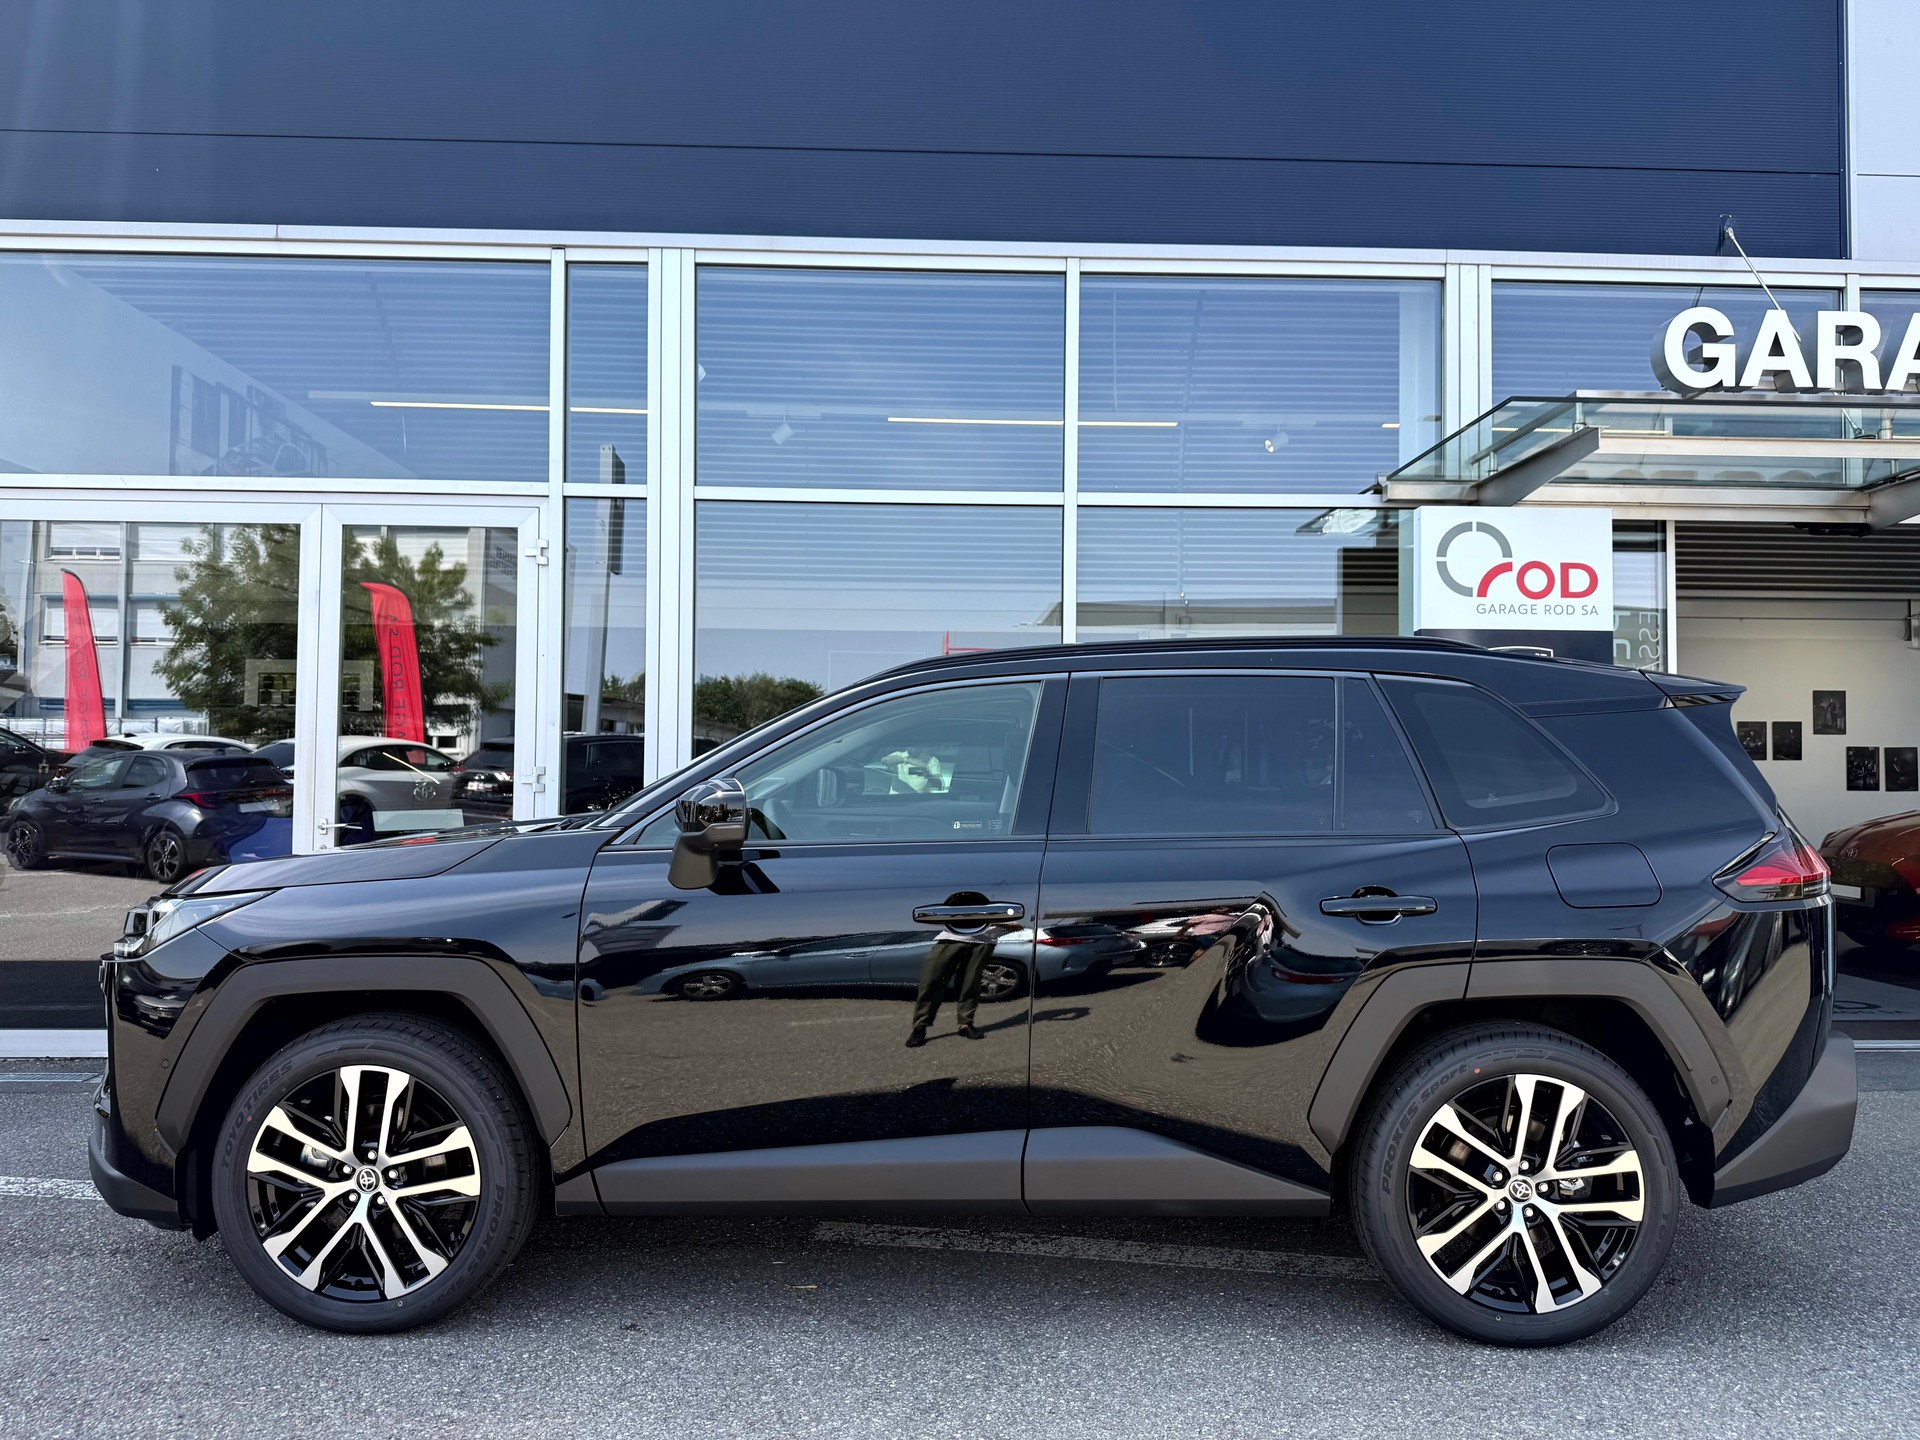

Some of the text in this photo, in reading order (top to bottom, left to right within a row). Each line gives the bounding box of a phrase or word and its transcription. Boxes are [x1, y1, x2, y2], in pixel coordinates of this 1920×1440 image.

[1476, 603, 1599, 616] GARAGE ROD SA
[222, 1060, 294, 1168] TOYO TIRES
[1382, 1101, 1420, 1195] PROXES
[466, 1184, 505, 1275] PROXES
